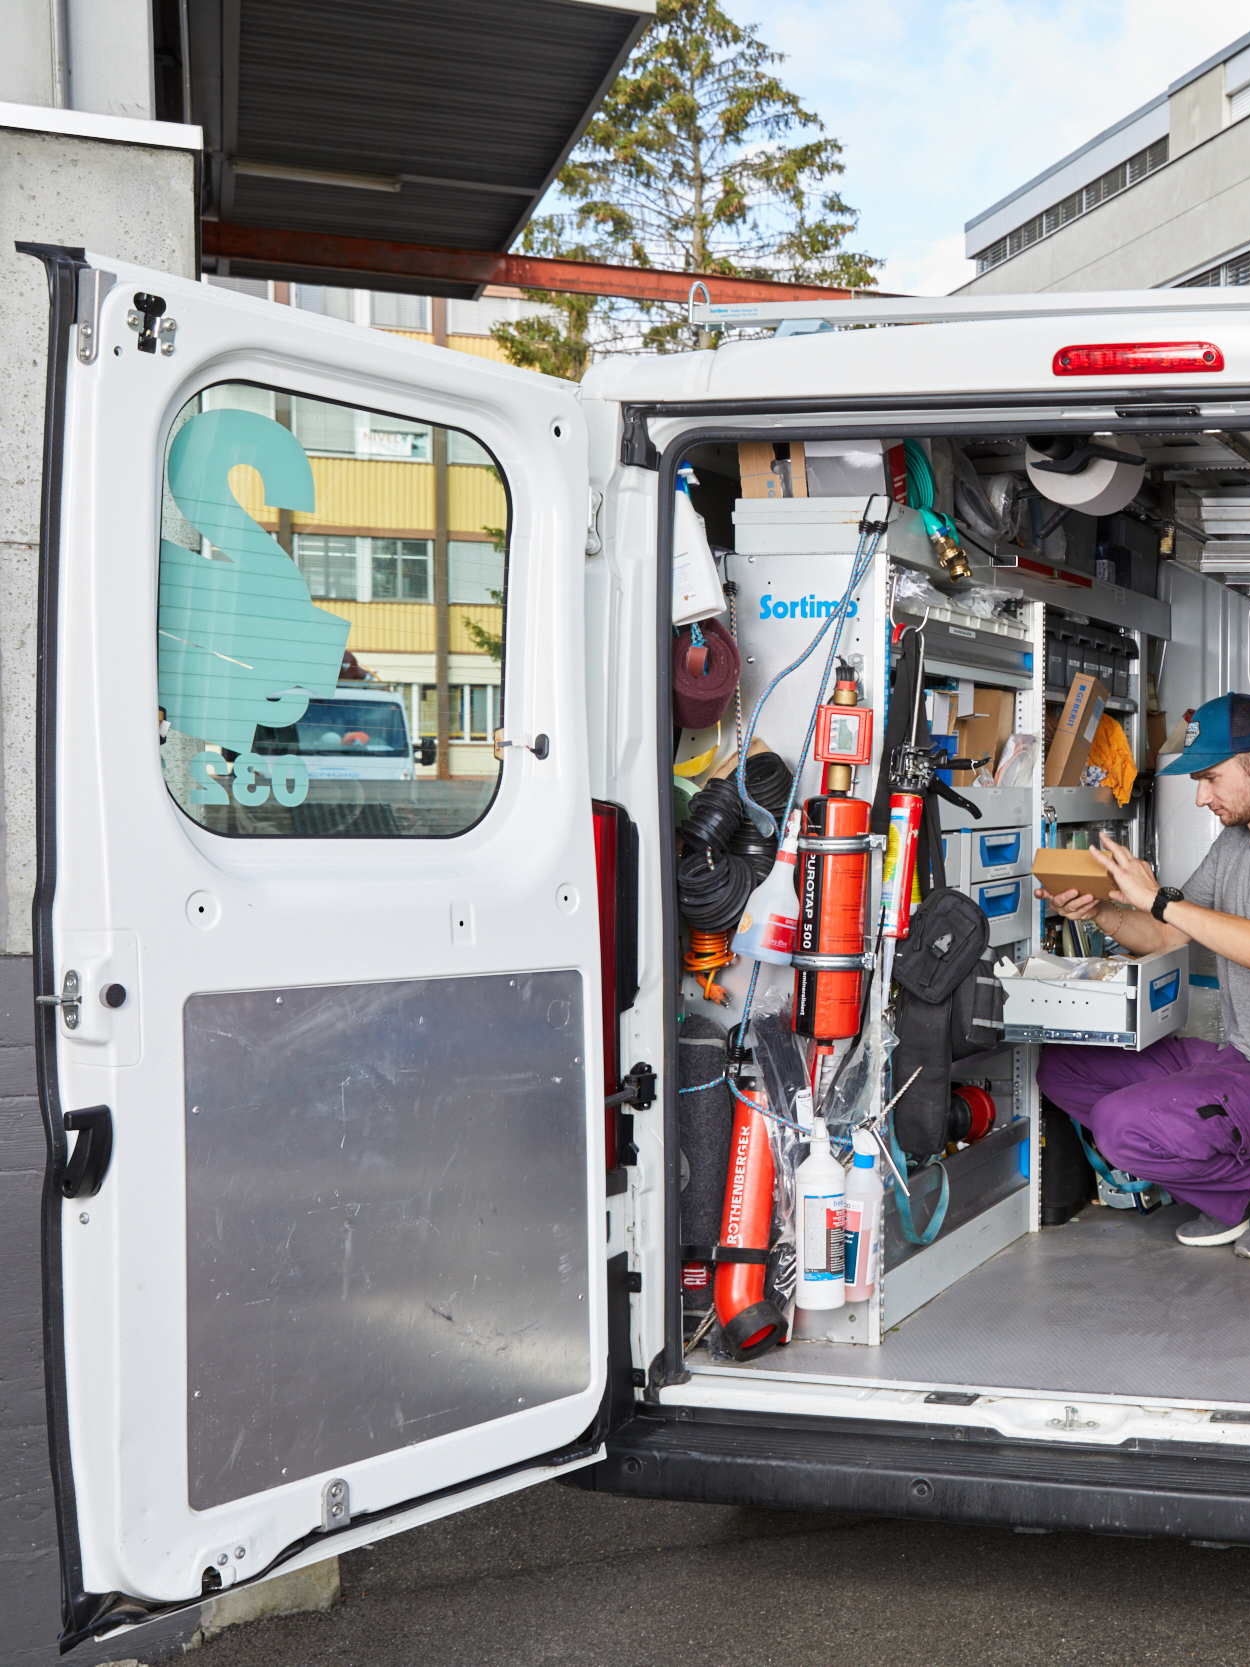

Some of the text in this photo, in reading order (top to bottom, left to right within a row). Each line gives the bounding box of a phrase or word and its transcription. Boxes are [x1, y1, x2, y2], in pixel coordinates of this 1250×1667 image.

[1067, 691, 1084, 728] GEBERIT
[803, 923, 812, 949] 500
[727, 1125, 750, 1245] ROTHENBERGER
